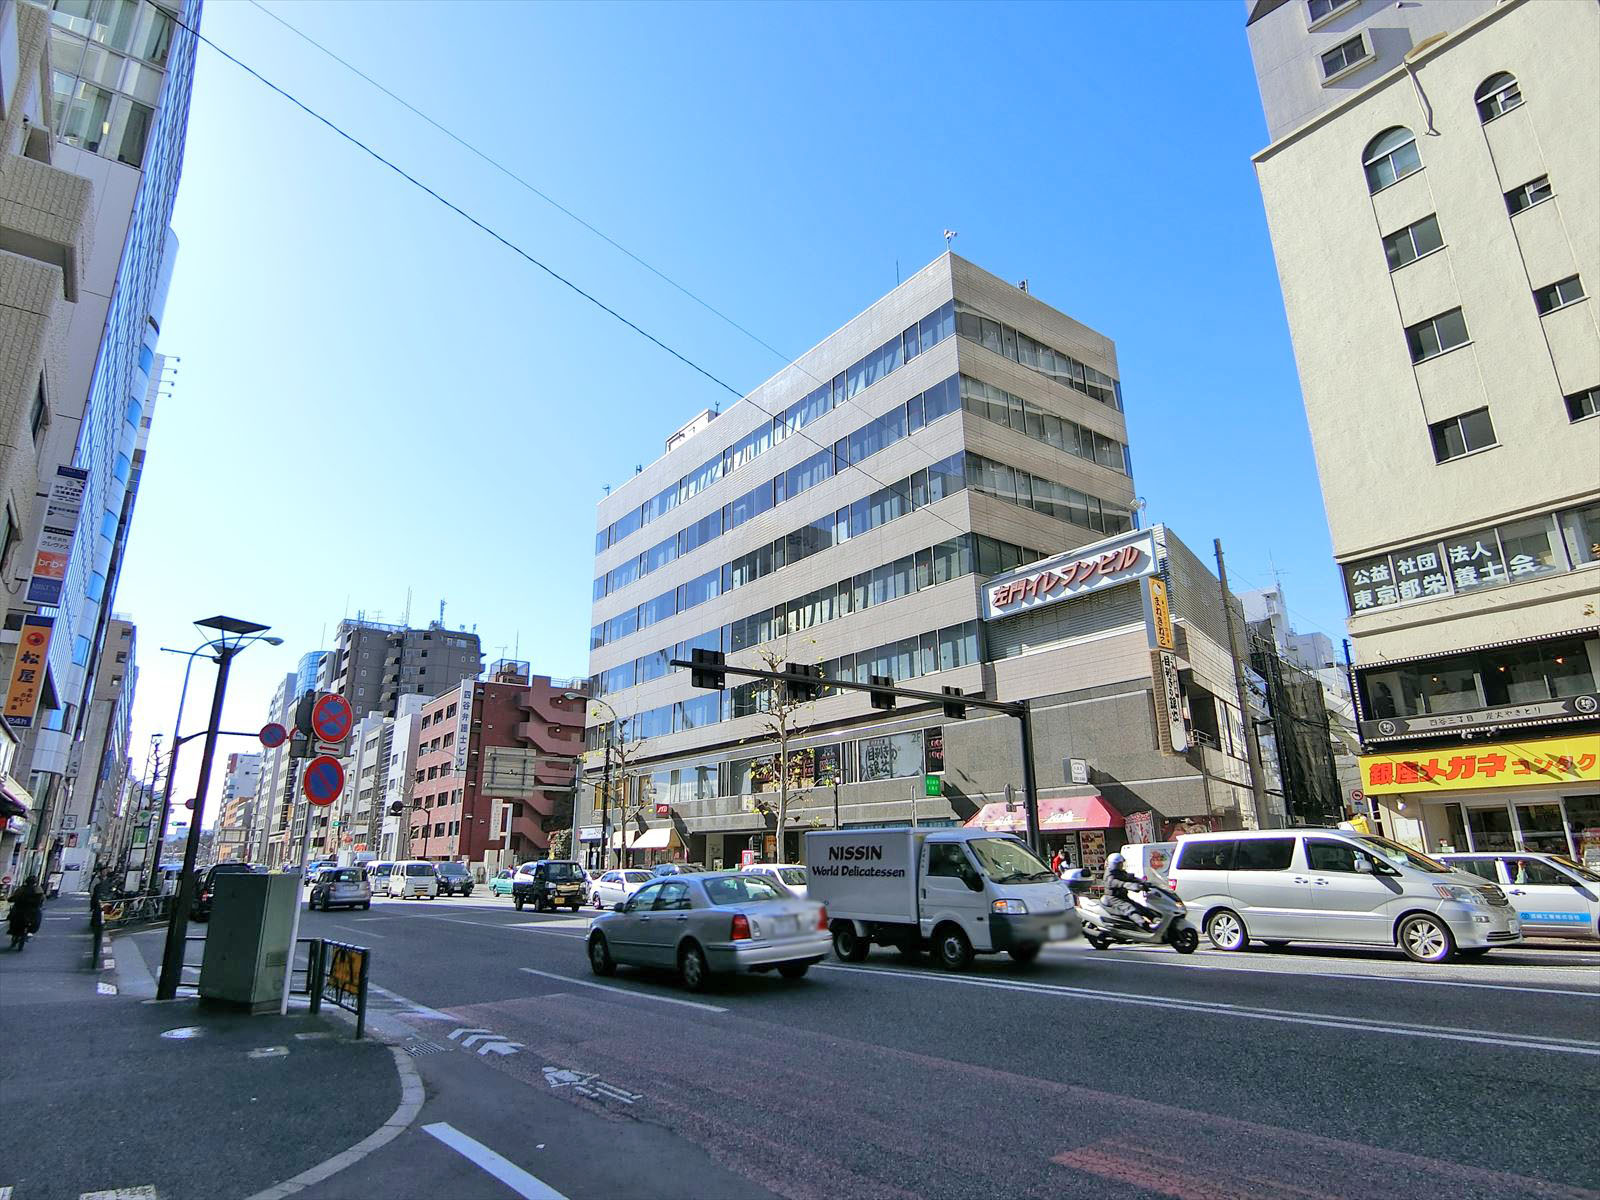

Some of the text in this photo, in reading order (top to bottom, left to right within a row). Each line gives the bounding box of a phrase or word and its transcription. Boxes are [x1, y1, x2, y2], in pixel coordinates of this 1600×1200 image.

[993, 546, 1140, 607] 左門イレブンビル
[1353, 541, 1491, 585] 公益社団法人
[1353, 554, 1539, 609] 東京都栄養士会
[1154, 597, 1166, 646] まねきねこ
[17, 651, 40, 683] 松屋
[458, 690, 471, 767] 四谷弁護士ビル
[1369, 753, 1506, 786] 銀座メガネ
[812, 865, 905, 878] World Delicatessen
[828, 845, 882, 861] NISSIN
